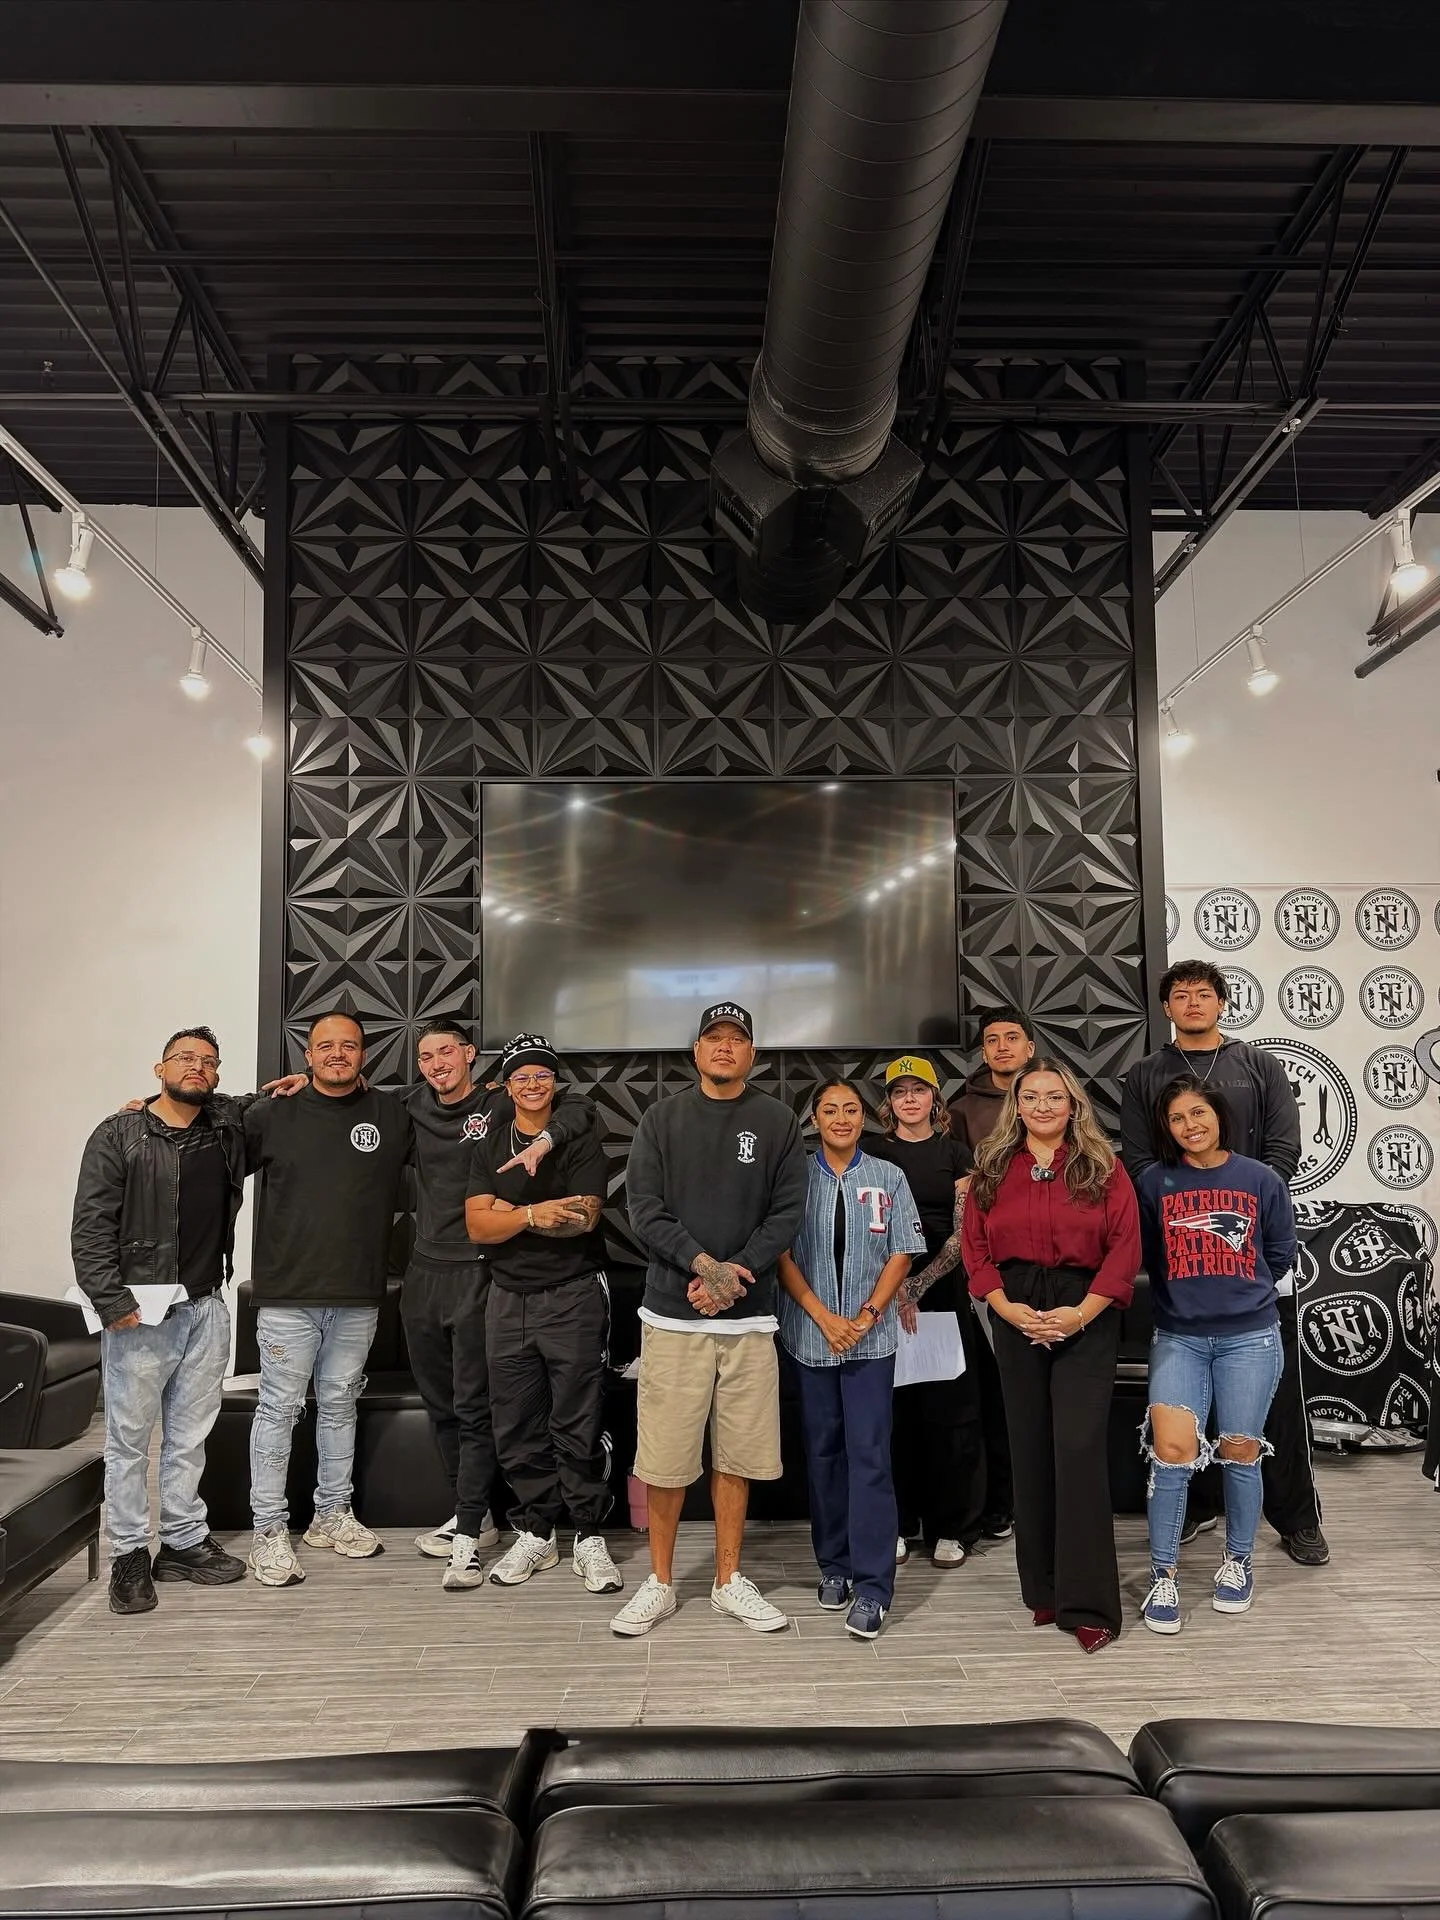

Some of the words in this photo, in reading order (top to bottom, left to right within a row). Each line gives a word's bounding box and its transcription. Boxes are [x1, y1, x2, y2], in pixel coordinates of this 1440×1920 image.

[1208, 897, 1219, 906] TOP
[1221, 896, 1243, 906] NOTCH
[1288, 896, 1299, 906] TOP
[1301, 895, 1323, 906] NOTCH
[1368, 896, 1379, 906] TOP
[1381, 895, 1404, 906] NOTCH
[1214, 935, 1244, 945] BARBERS
[1294, 934, 1324, 944] BARBERS
[1375, 934, 1404, 944] BARBERS
[1291, 975, 1303, 985] TOP
[1304, 974, 1327, 985] NOTCH
[1372, 975, 1384, 985] TOP
[1385, 974, 1408, 984] NOTCH
[710, 1006, 744, 1021] TEXAS
[1298, 1013, 1328, 1024] BARBERS
[1379, 1013, 1409, 1024] BARBERS
[1376, 1054, 1388, 1064] TOP
[1389, 1053, 1412, 1064] NOTCH
[1383, 1093, 1414, 1103] BARBERS
[1380, 1134, 1393, 1144] TOP
[1393, 1133, 1416, 1144] NOTCH
[1387, 1173, 1418, 1183] BARBERS
[1162, 1189, 1258, 1218] PATRIOTS
[856, 1187, 892, 1233] T
[1167, 1253, 1256, 1281] PATRIOTS
[1311, 1303, 1326, 1316] TOP
[1329, 1299, 1361, 1307] NOTCH
[1337, 1344, 1377, 1366] BARBERS
[1312, 1407, 1345, 1419] NOTCH
